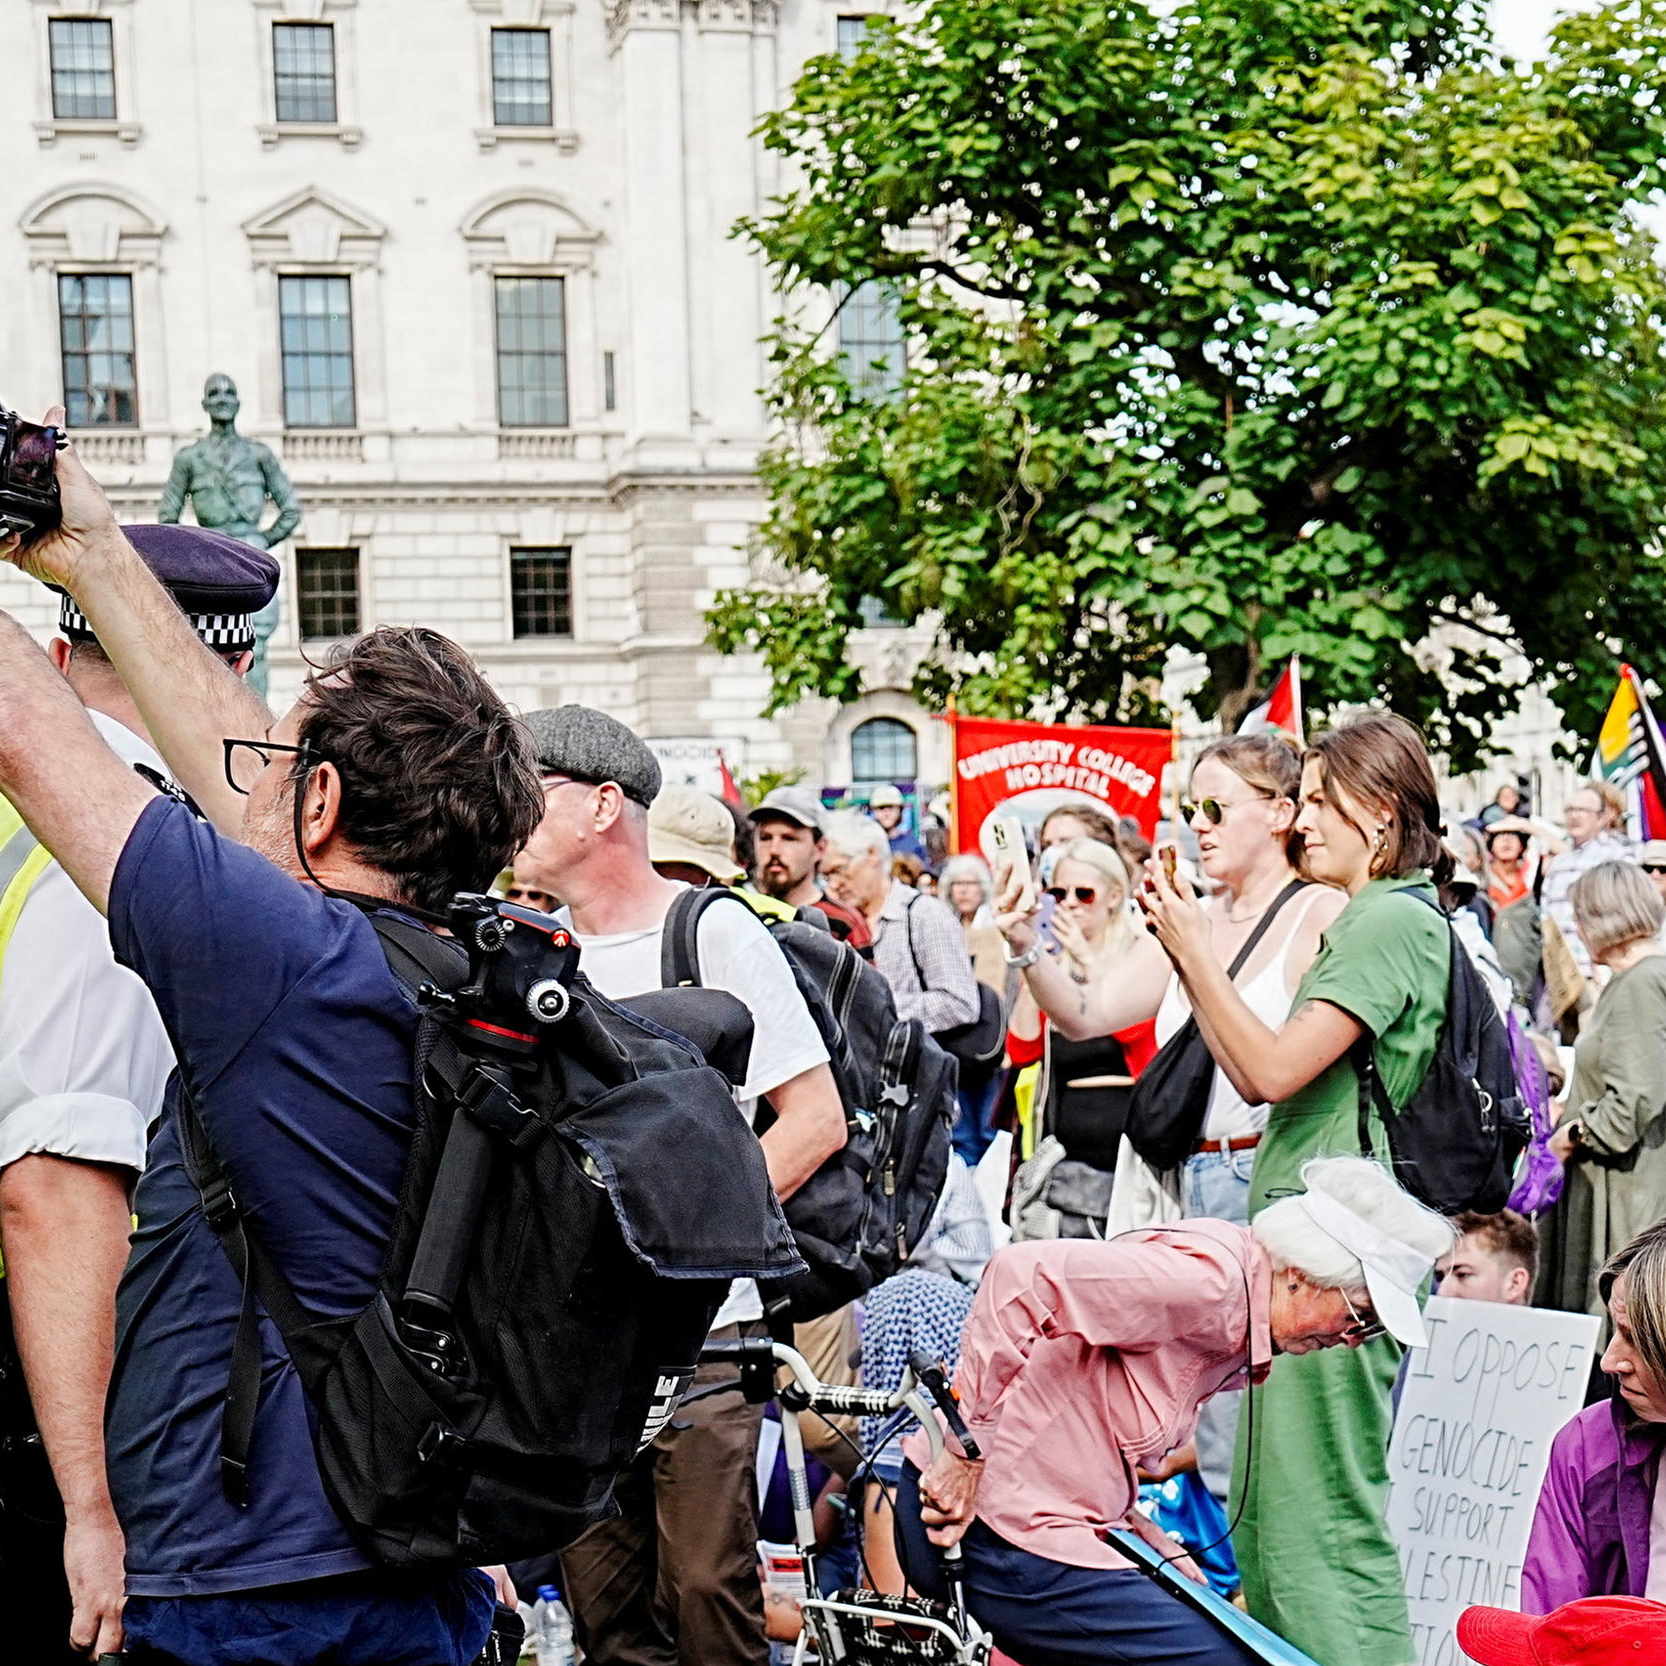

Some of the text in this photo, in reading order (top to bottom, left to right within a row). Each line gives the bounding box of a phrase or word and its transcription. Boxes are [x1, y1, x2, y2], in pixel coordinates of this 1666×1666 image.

[958, 740, 1156, 798] UNIVERSITY COLLEGE
[1005, 762, 1110, 799] HOSPITAL
[1412, 1317, 1448, 1378] I
[1401, 1413, 1533, 1496] GENOCIDE
[1408, 1487, 1514, 1549] SUPPORT
